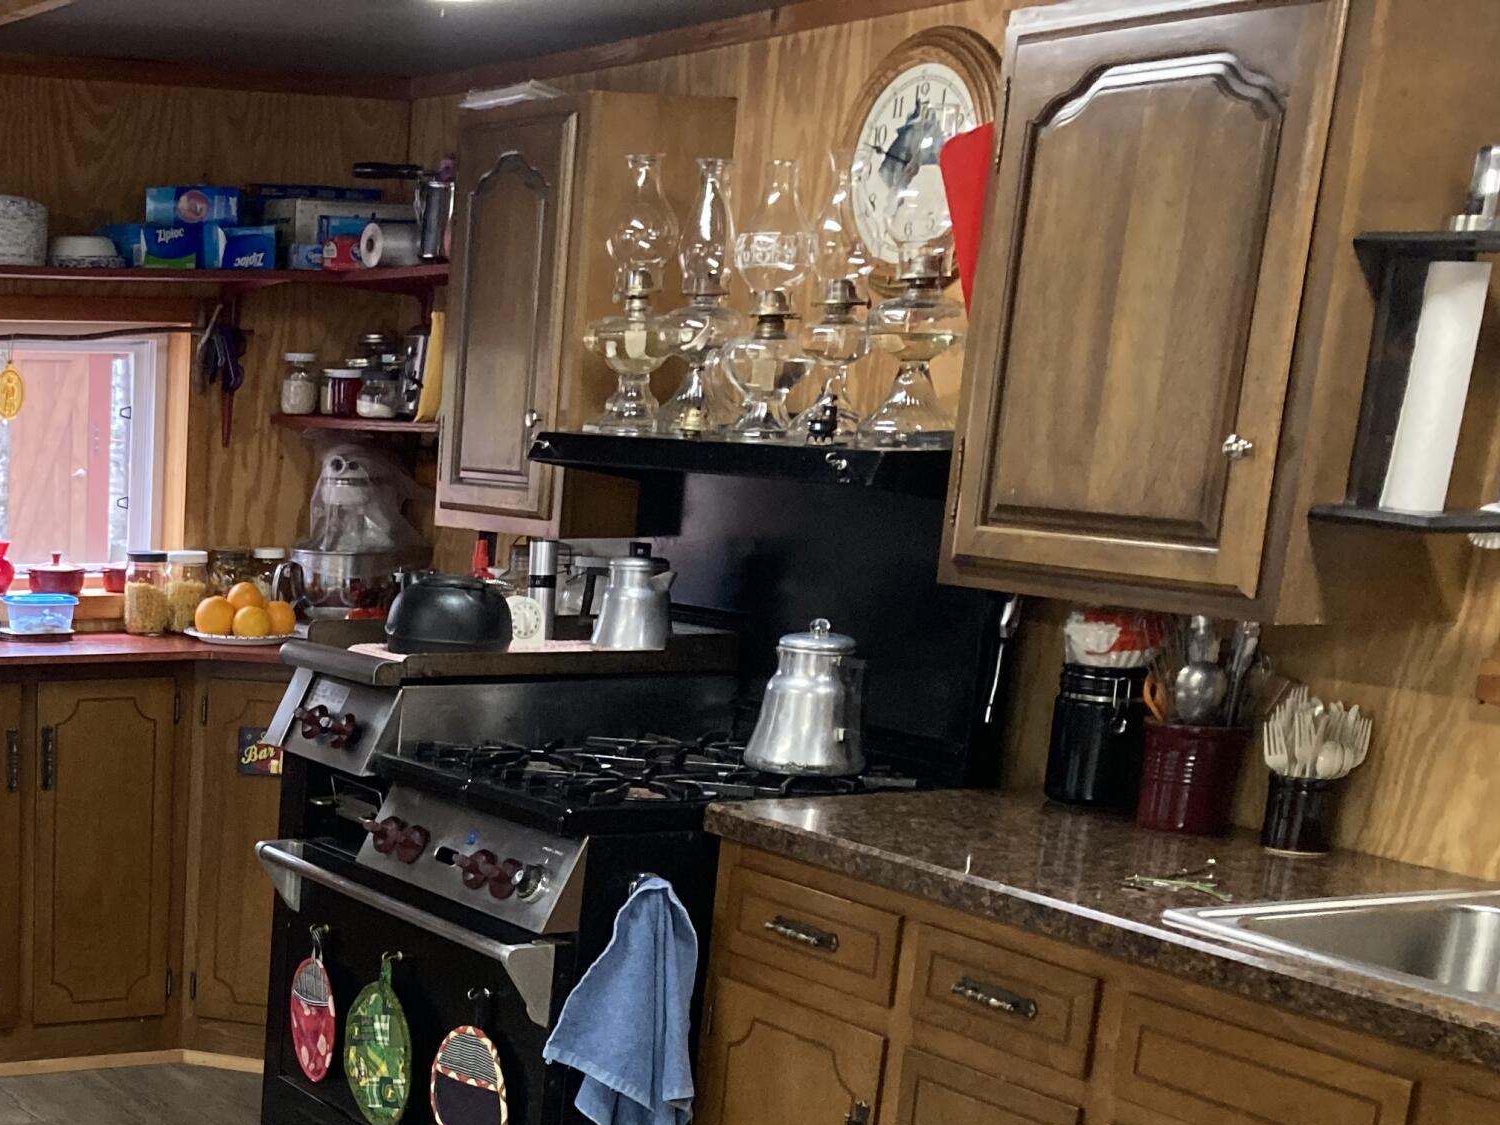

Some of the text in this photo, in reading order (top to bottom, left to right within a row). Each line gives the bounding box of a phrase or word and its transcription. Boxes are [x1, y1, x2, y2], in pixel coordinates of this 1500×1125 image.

[892, 95, 905, 119] 11
[155, 227, 185, 244] Ziploc
[903, 220, 913, 237] 6
[233, 252, 265, 268] Ziploc
[241, 744, 276, 765] Bar
